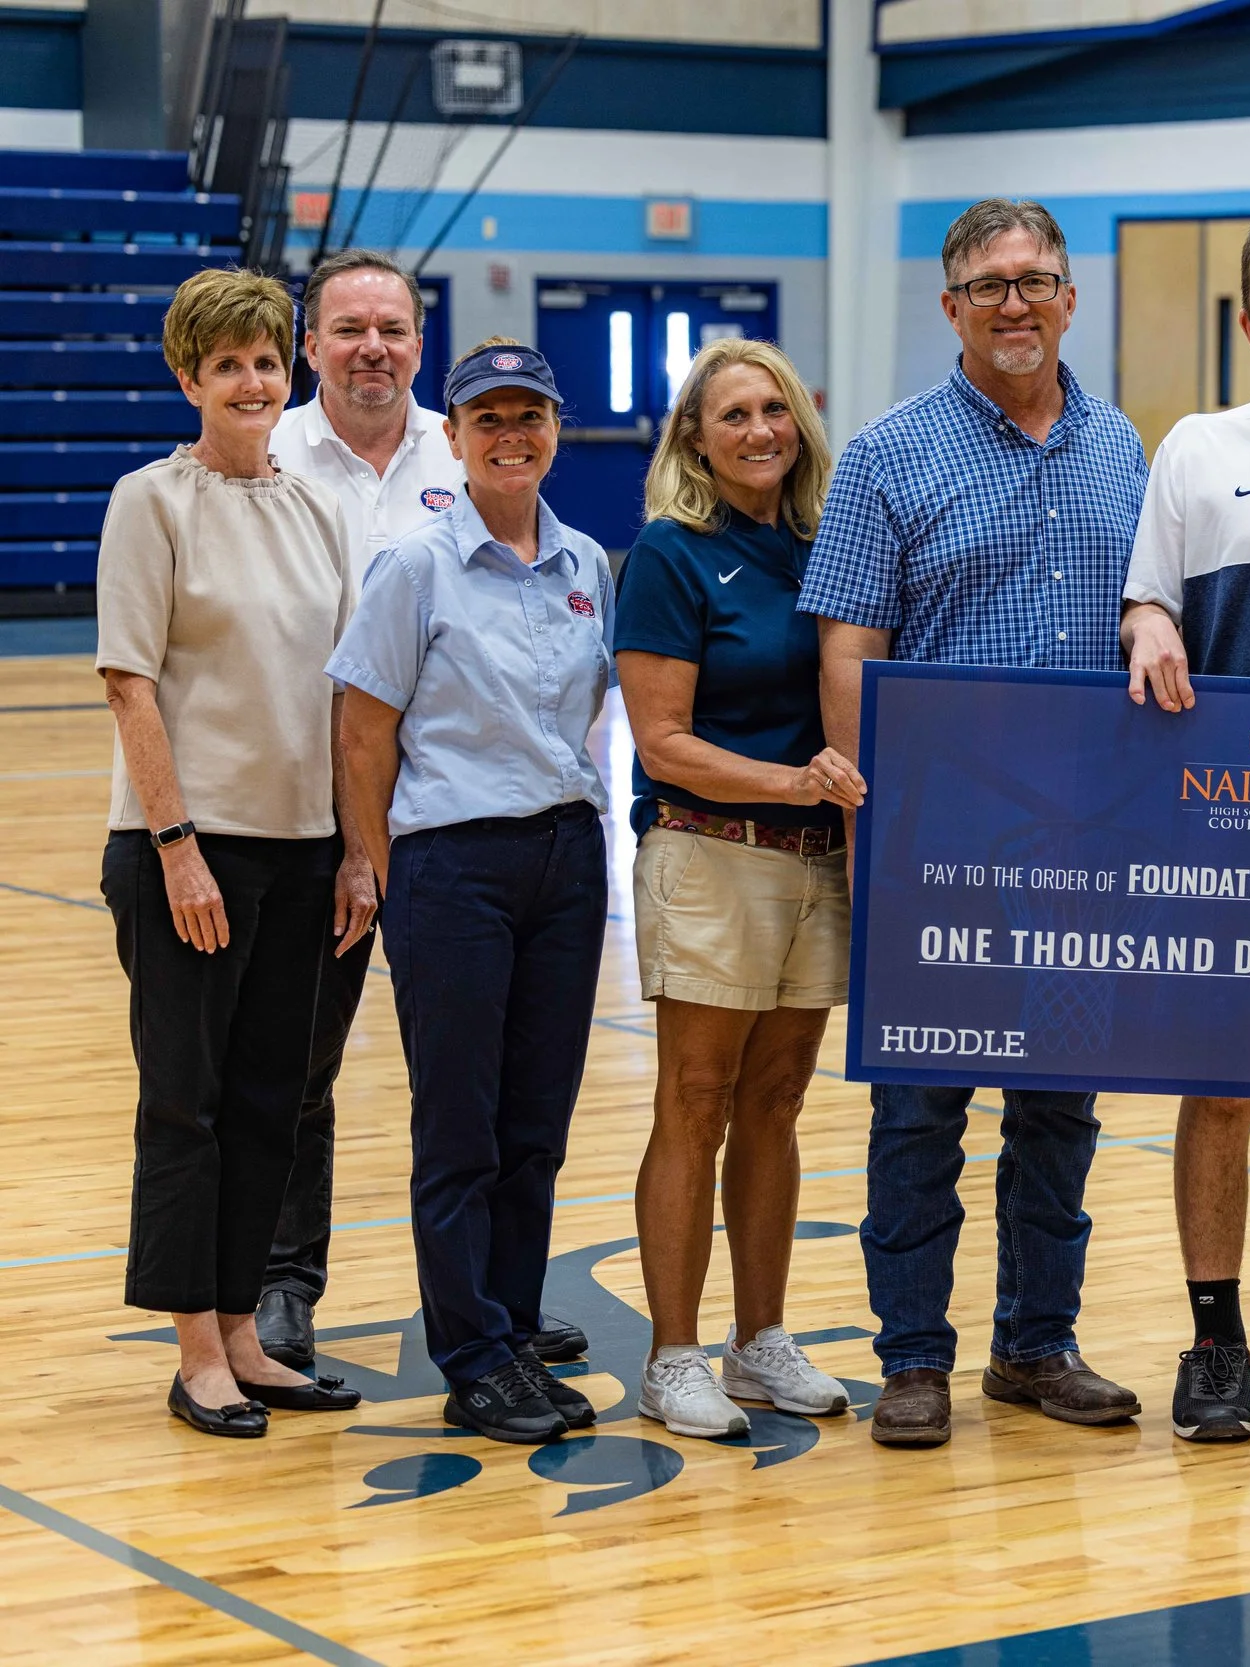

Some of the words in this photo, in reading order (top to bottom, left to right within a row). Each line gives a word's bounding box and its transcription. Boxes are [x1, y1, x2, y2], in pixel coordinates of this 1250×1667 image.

[1209, 806, 1240, 816] HIGH
[922, 863, 957, 885] PAY
[963, 865, 985, 886] TO
[992, 866, 1024, 888] THE
[1030, 868, 1088, 891] ORDER
[1096, 871, 1117, 892] OF
[920, 925, 993, 963] ONE
[1010, 929, 1216, 973] THOUSAND
[880, 1025, 1026, 1058] HUDDLE
